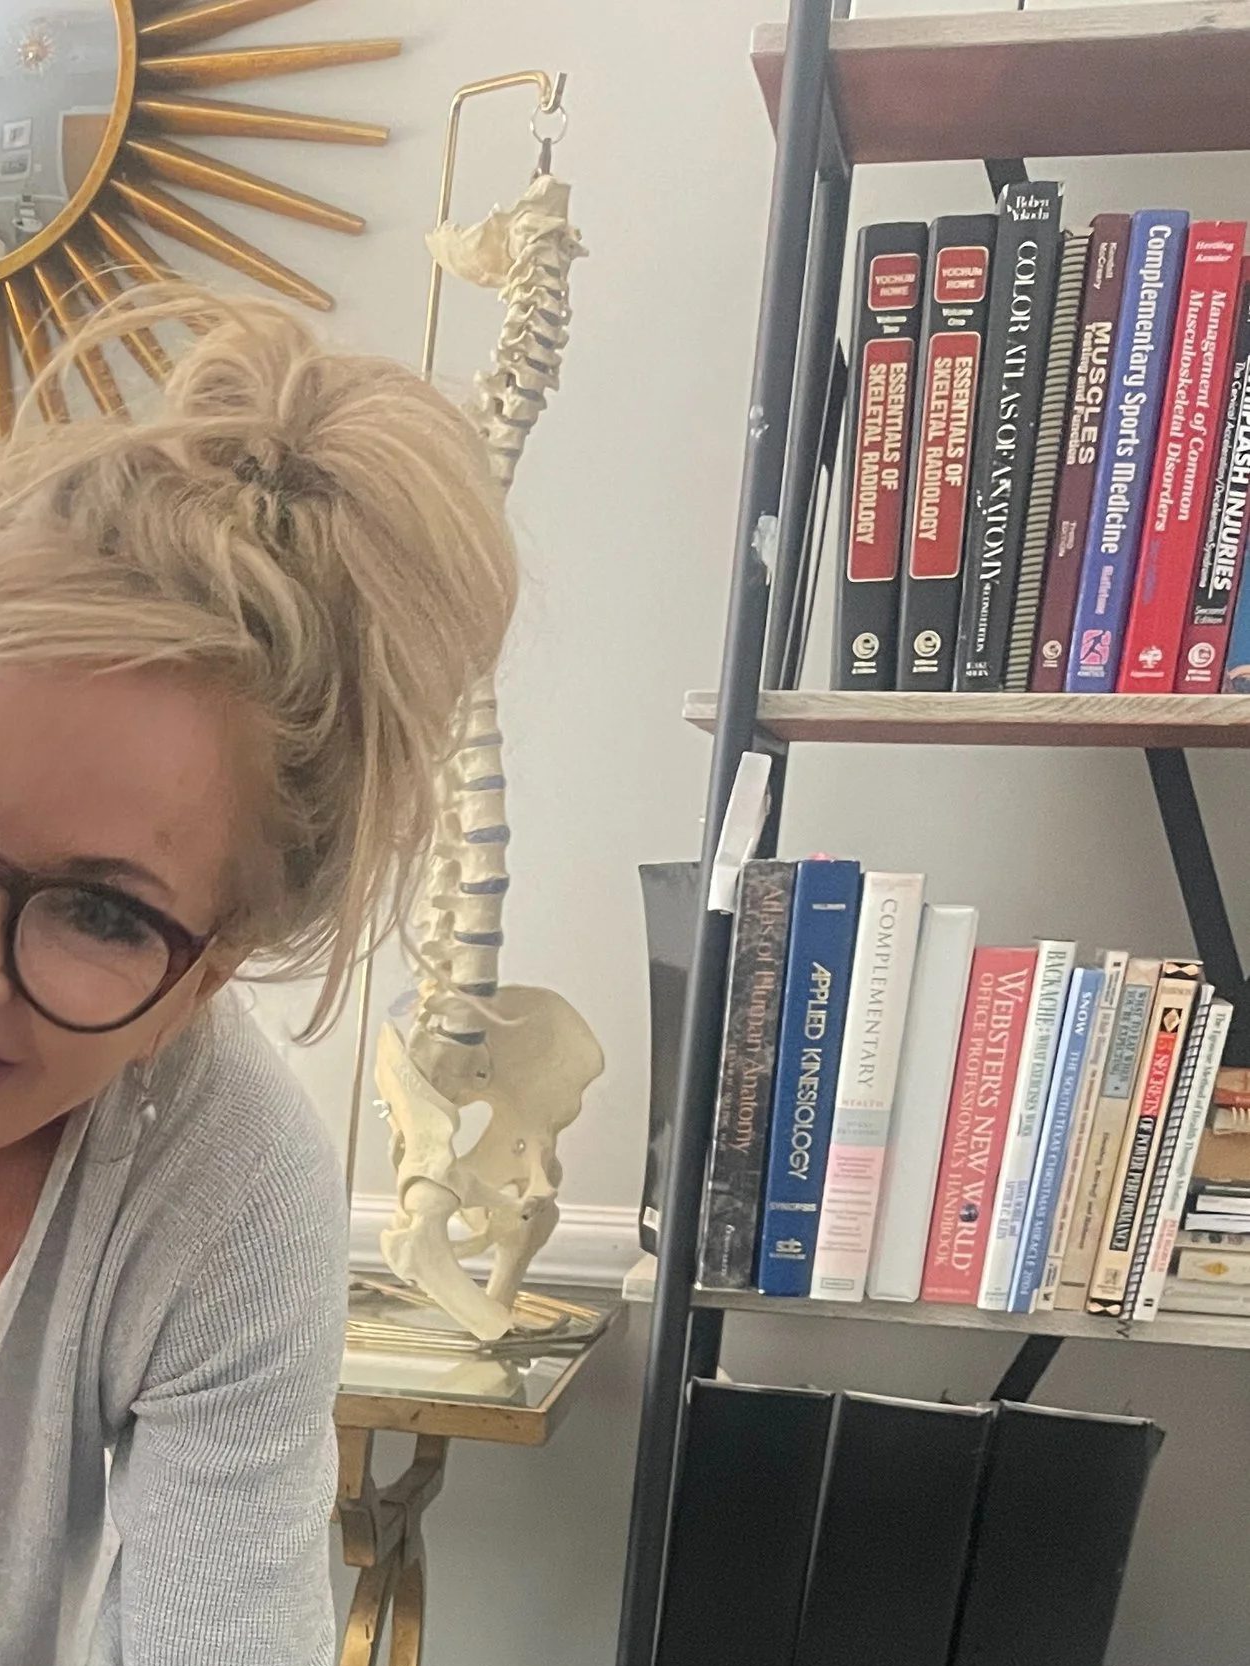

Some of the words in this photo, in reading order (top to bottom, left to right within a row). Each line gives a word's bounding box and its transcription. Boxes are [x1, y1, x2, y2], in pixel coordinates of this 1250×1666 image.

[942, 266, 983, 278] YOCHUM
[1008, 241, 1038, 333] COLOR
[1122, 224, 1172, 387] Complementary
[1000, 343, 1027, 420] ATLAS
[1077, 322, 1096, 373] Testing
[1168, 290, 1205, 438] Musculoskeletal
[1197, 289, 1227, 409] Management
[1234, 361, 1246, 378] The
[863, 363, 887, 447] SKELETAL
[882, 362, 907, 463] ESSENTIALS
[927, 356, 952, 442] SKELETAL
[946, 356, 973, 459] ESSENTIALS
[1075, 374, 1087, 403] and
[1078, 321, 1113, 464] MUSCLES
[1116, 391, 1147, 457] Sports
[1189, 411, 1207, 436] of
[1226, 381, 1242, 420] Cervical
[996, 424, 1018, 460] OF
[1066, 404, 1086, 465] Function
[856, 452, 880, 544] RADIOLOGY
[881, 468, 899, 490] OF
[919, 447, 943, 541] RADIOLOGY
[945, 465, 963, 487] OF
[1100, 462, 1136, 554] Medicine
[1155, 441, 1181, 531] Disorders
[1178, 437, 1204, 521] Common
[980, 461, 1012, 584] ANATOMY
[1213, 491, 1246, 590] INJURIES
[758, 885, 785, 937] Atlas
[756, 944, 781, 965] of
[746, 970, 775, 1053] Human
[804, 961, 831, 1040] APPLIED
[857, 897, 897, 1089] COMPLEMENTARY
[971, 972, 994, 1032] OFFICE
[1074, 991, 1092, 1036] SNOW
[1215, 1014, 1226, 1028] The
[977, 968, 1029, 1108] WEBSTER'S
[1066, 1051, 1079, 1072] THE
[729, 1057, 765, 1154] Anatomy
[787, 1048, 823, 1180] KINESIOLOGY
[951, 1038, 984, 1168] PROFESSIONAL'S
[1057, 1076, 1076, 1117] SOUTH
[1141, 1054, 1171, 1116] SECRETS
[968, 1115, 996, 1175] NEW
[1051, 1118, 1067, 1151] TEXAS
[1129, 1134, 1152, 1170] POWER
[1140, 1117, 1154, 1131] OF
[934, 1173, 962, 1266] HANDBOOK
[1036, 1154, 1057, 1217] CHRISTMAS
[1112, 1171, 1142, 1250] PERFORMANCE
[1025, 1218, 1044, 1266] MIRACLE
[1019, 1269, 1034, 1295] 2004
